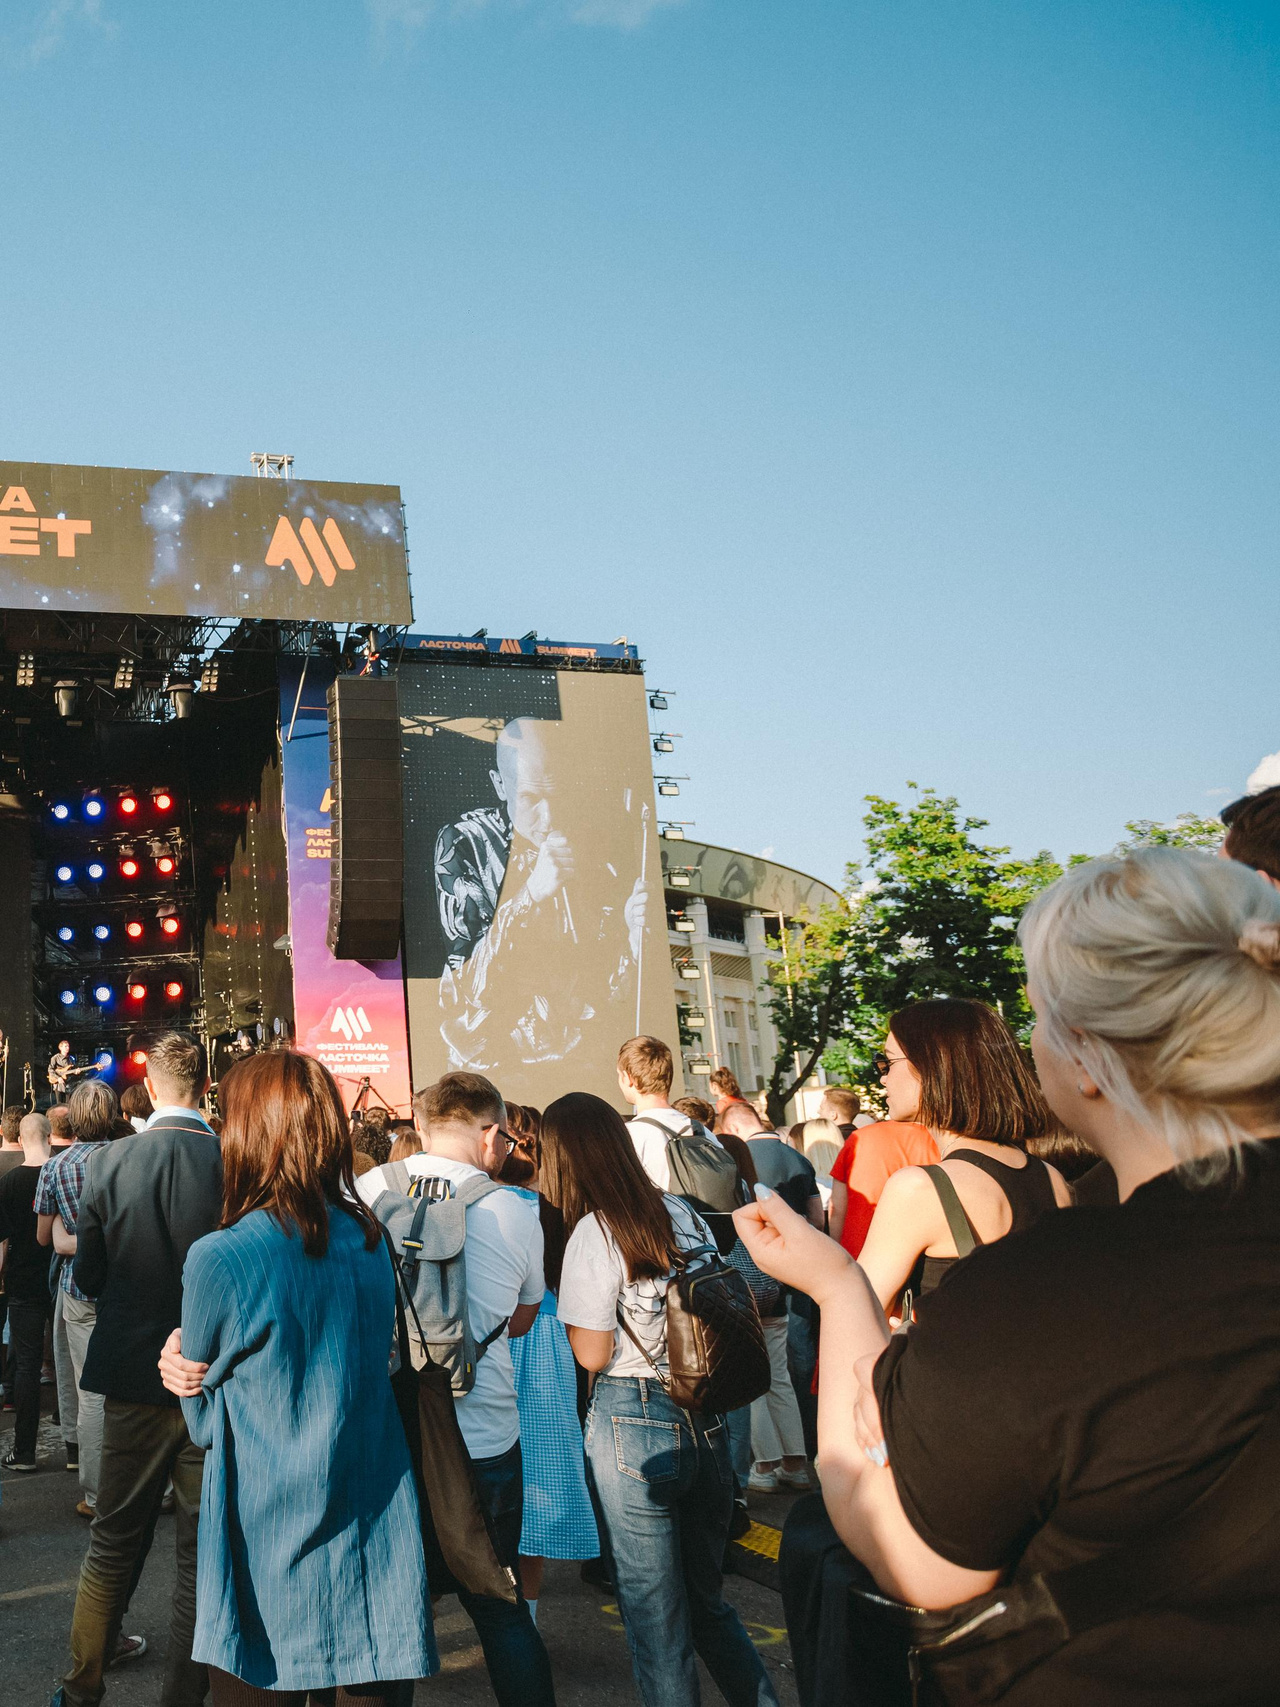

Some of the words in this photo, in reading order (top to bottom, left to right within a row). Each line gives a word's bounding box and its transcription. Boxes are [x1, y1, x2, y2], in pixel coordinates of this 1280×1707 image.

[419, 640, 486, 650] ЛАСТОЧКА
[536, 646, 597, 658] SUMMEET
[316, 1042, 389, 1051] ФЕСТИВАЛЬ
[317, 1053, 390, 1062] ЛАСТОЧКА
